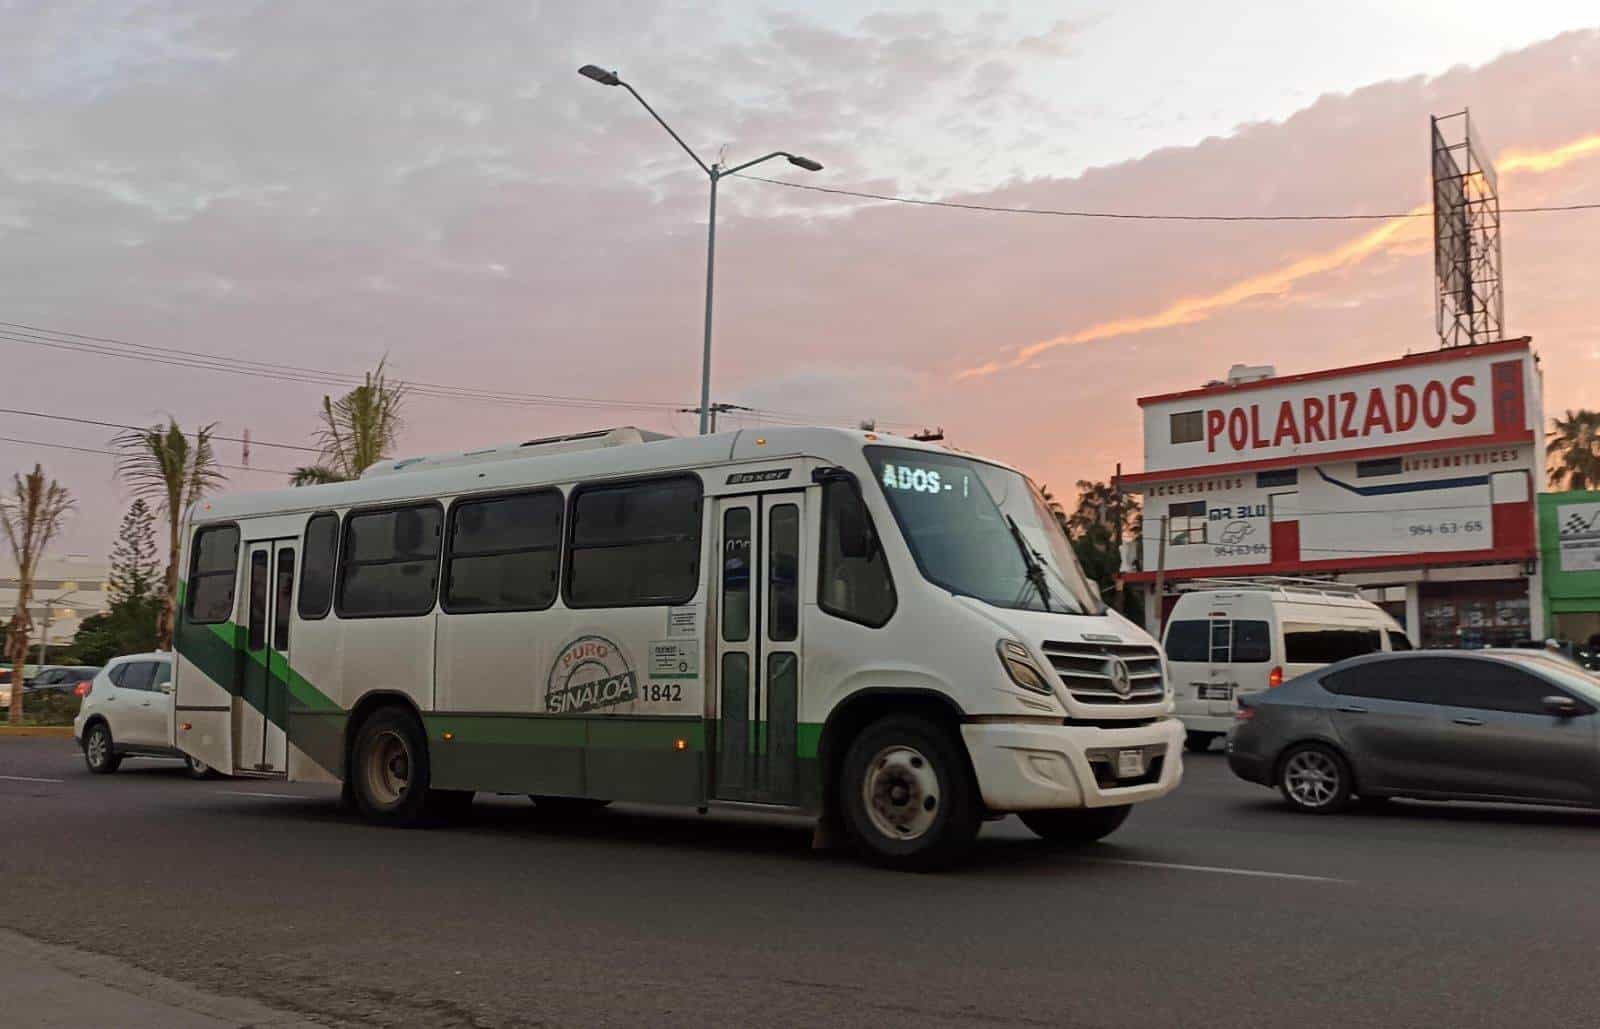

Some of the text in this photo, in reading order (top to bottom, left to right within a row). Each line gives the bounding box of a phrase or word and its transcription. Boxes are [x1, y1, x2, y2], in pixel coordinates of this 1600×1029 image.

[1207, 375, 1477, 453] POLARIZADOS
[563, 644, 608, 668] PURO
[549, 675, 632, 713] SINALOA
[642, 684, 682, 702] 1842
